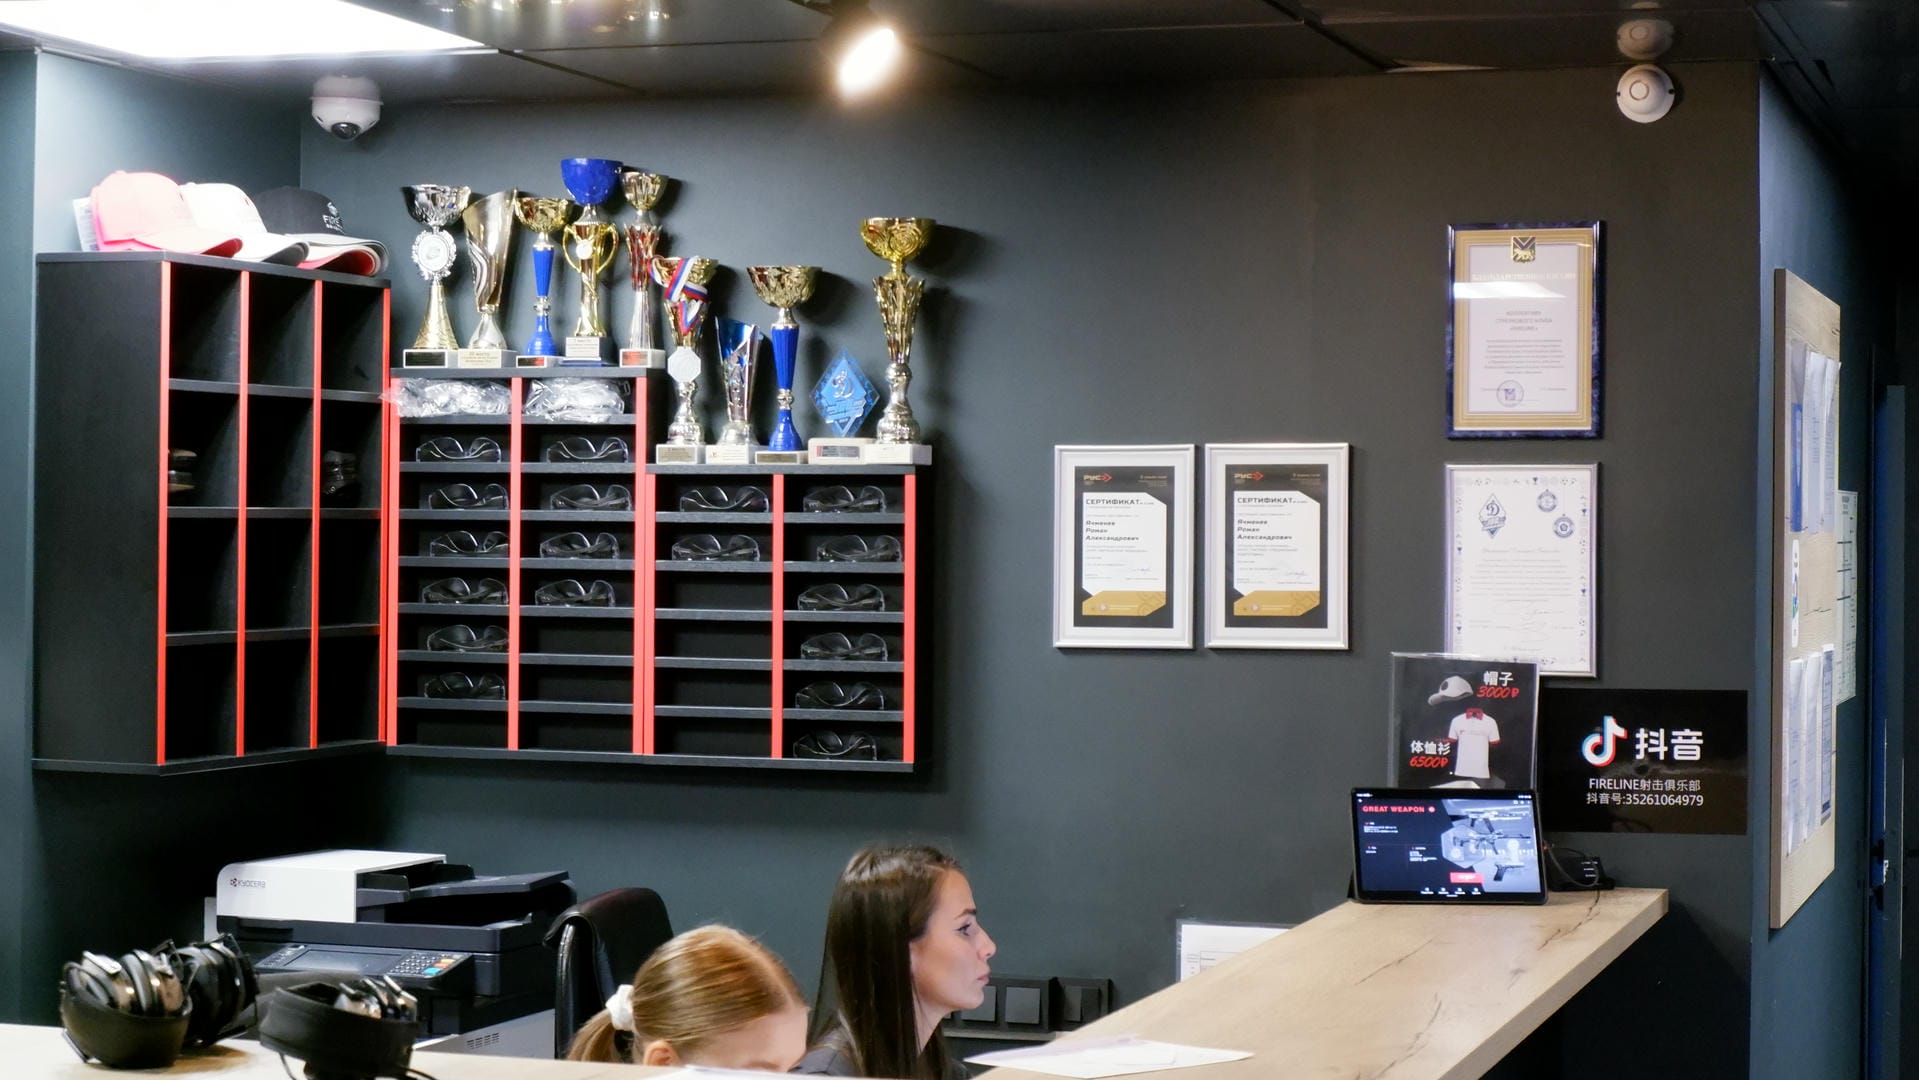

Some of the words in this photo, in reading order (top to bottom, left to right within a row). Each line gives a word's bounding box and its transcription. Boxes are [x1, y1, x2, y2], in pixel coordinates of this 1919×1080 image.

[1483, 671, 1514, 687] 帽子
[1410, 740, 1451, 755] 体恤衫
[1635, 728, 1704, 761] 抖音
[1589, 778, 1701, 792] FIRELINE射击俱乐部
[1586, 792, 1704, 806] 抖音号:35261064979
